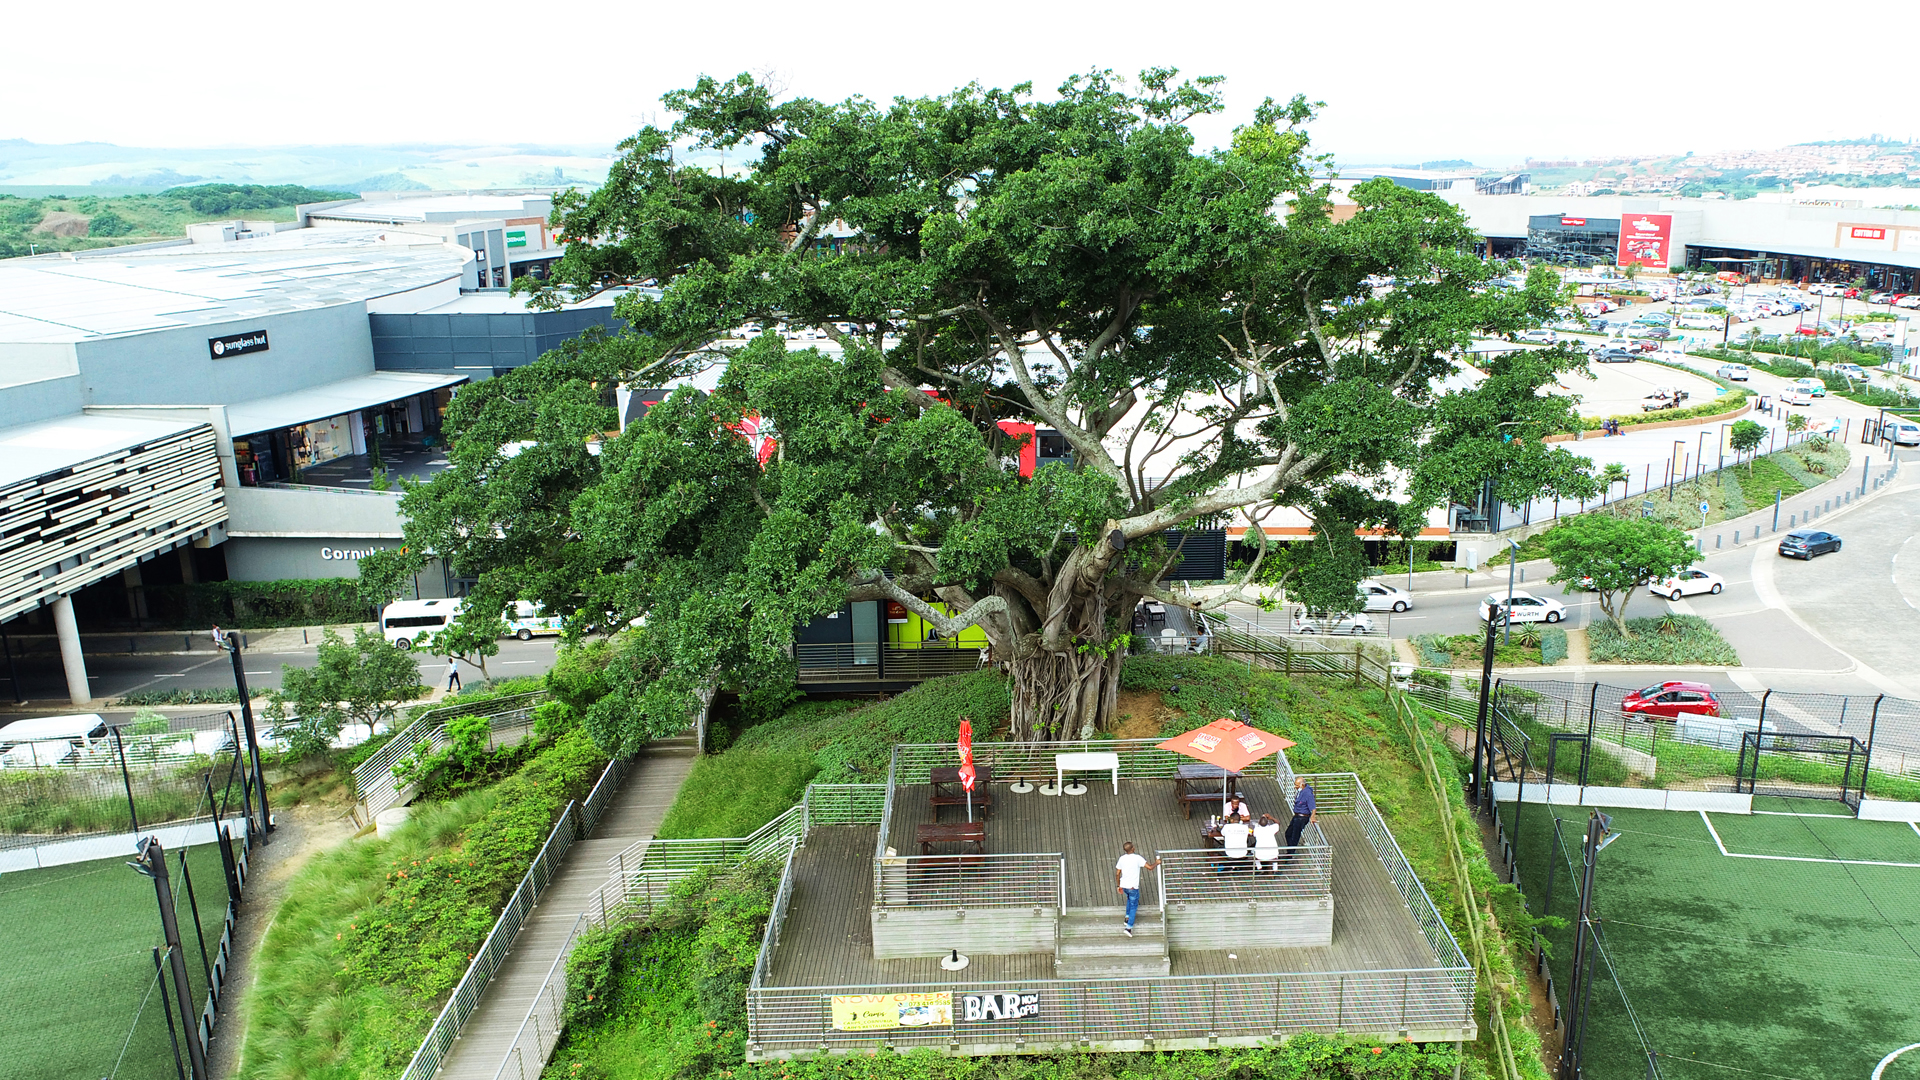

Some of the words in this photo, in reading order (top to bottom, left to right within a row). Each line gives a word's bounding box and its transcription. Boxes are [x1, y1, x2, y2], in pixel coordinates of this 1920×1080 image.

[225, 338, 254, 350] sunglass
[254, 335, 266, 345] hut
[833, 995, 885, 1004] NOW
[893, 993, 949, 1002] OPEN
[1021, 994, 1038, 1005] NOW
[963, 994, 1021, 1021] BAR
[1020, 1004, 1038, 1016] OPEN
